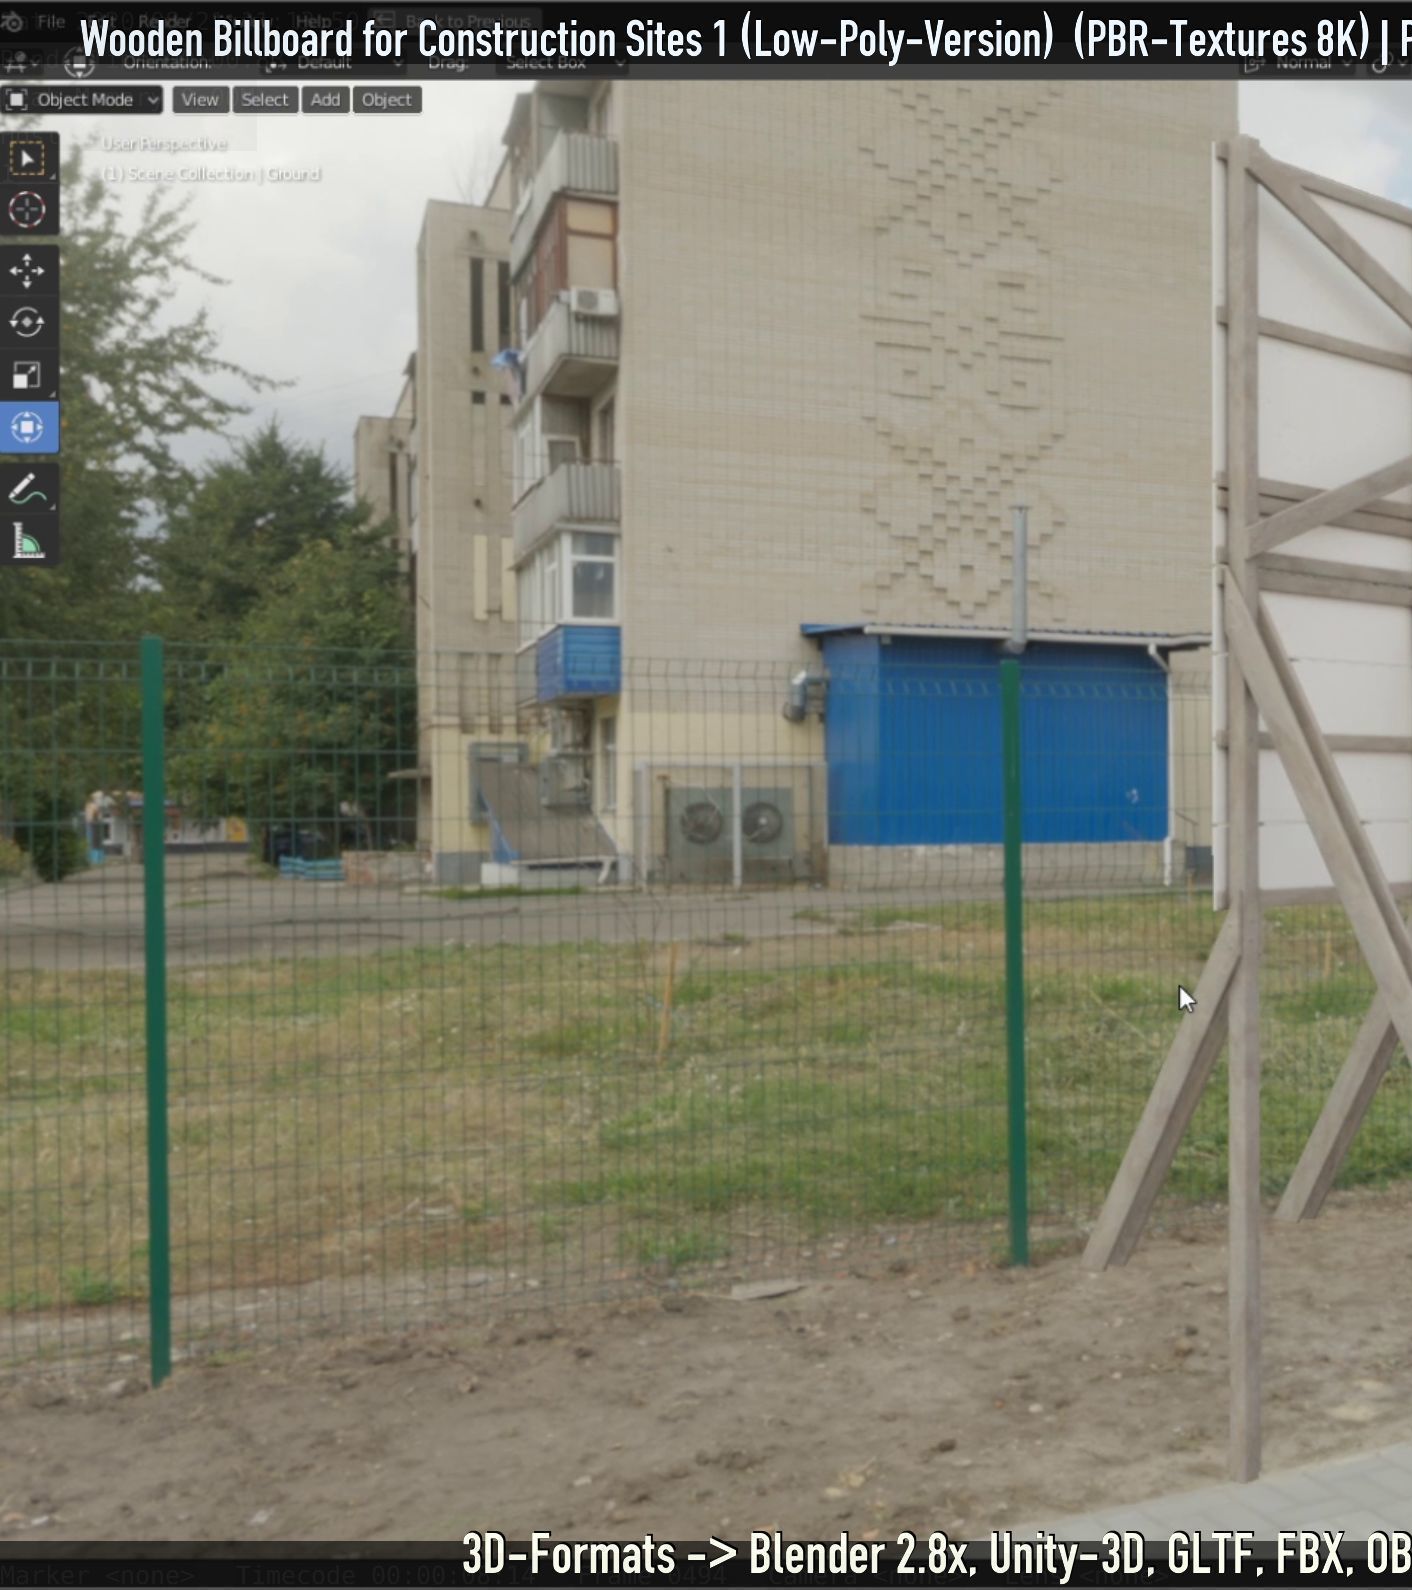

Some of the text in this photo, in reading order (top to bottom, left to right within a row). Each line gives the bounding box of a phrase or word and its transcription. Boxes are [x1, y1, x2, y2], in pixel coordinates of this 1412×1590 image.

[298, 56, 352, 70] Default
[38, 92, 134, 110] Object Mode
[181, 93, 219, 107] View
[241, 93, 289, 107] Select
[310, 93, 341, 107] Add
[362, 93, 413, 110] Object
